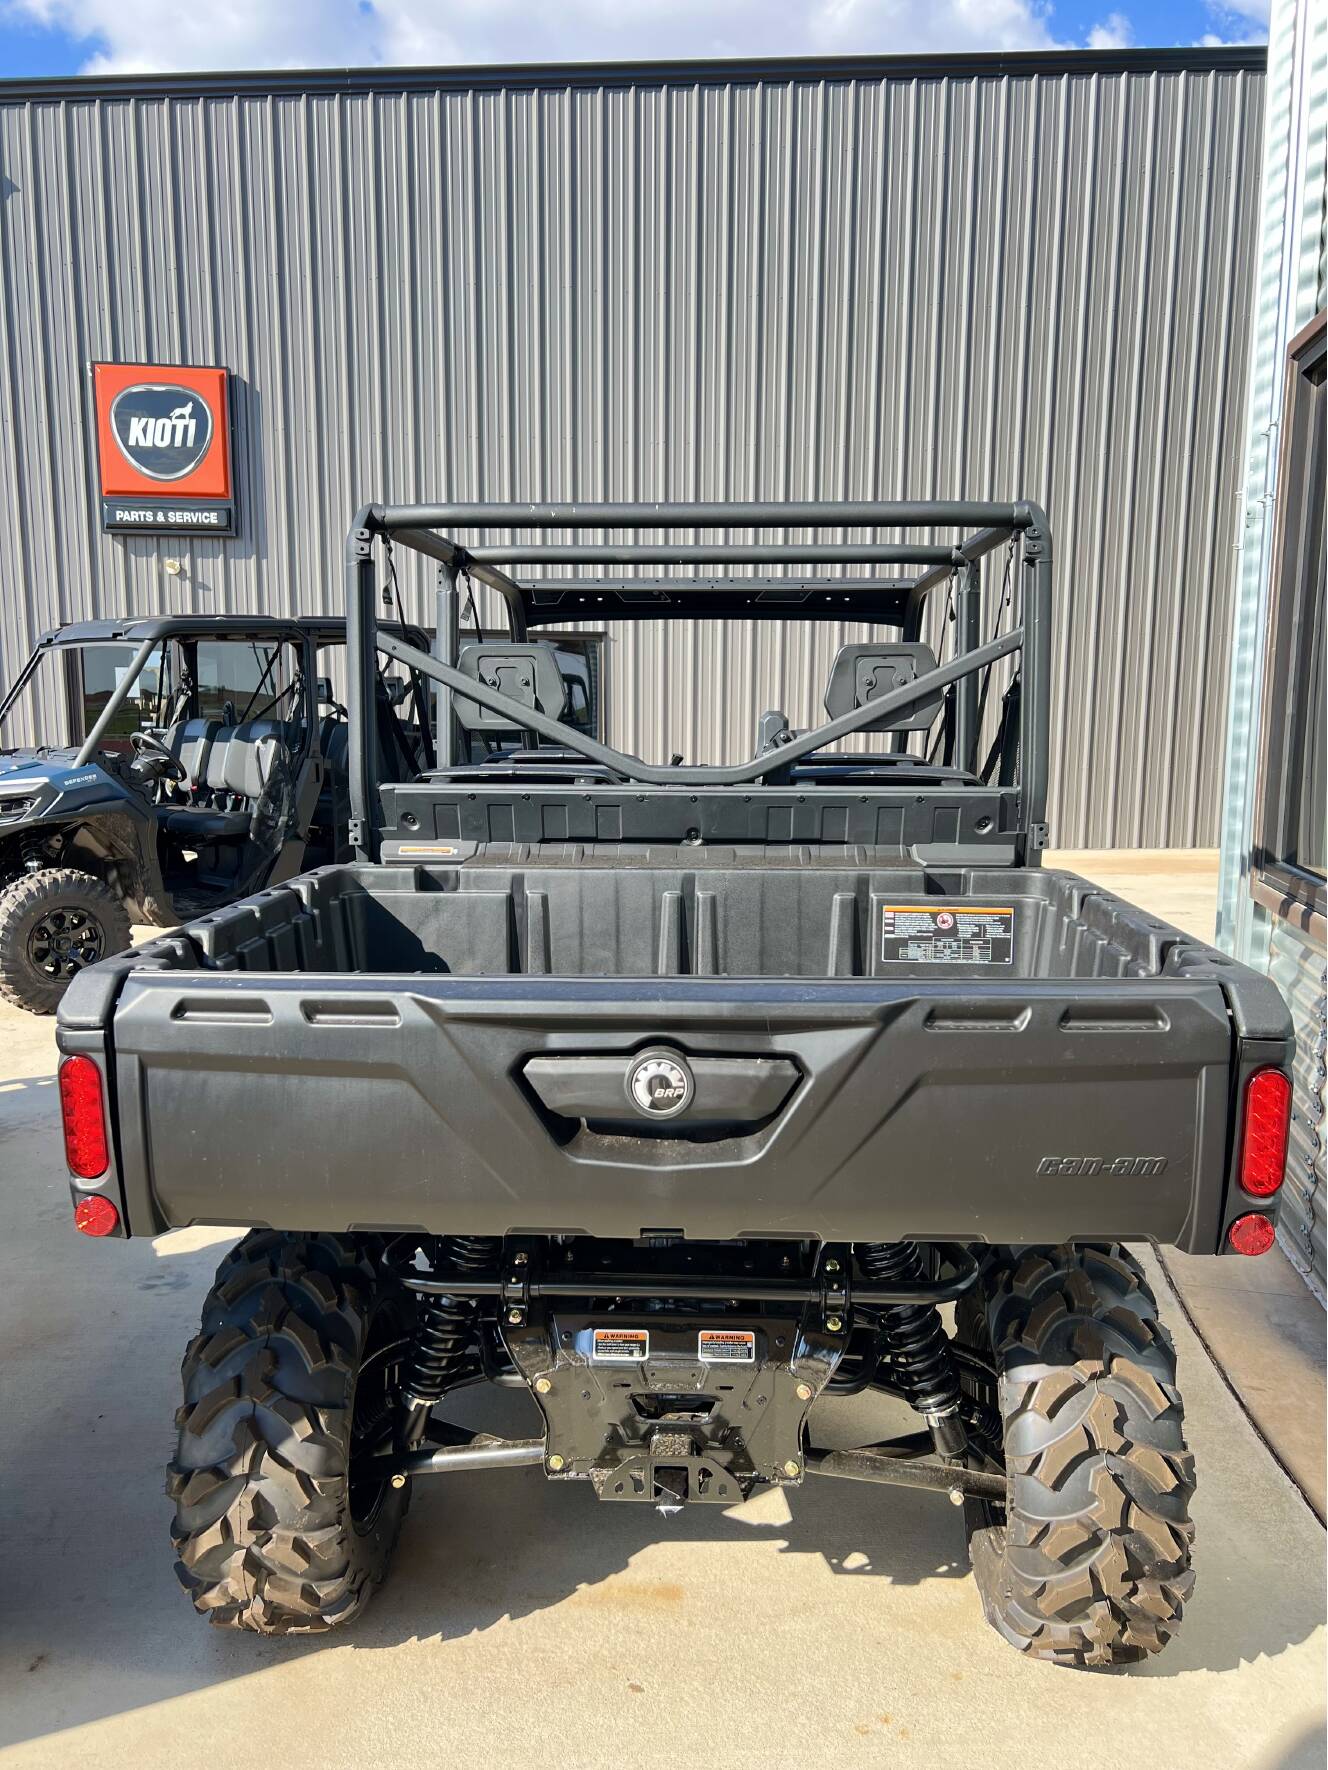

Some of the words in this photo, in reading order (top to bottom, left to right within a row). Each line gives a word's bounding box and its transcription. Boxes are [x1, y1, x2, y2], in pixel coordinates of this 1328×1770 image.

[128, 416, 197, 448] KIOTI
[115, 510, 154, 522] PARTS
[156, 511, 166, 522] &
[167, 511, 218, 523] SERVICE
[654, 1088, 684, 1098] BRP
